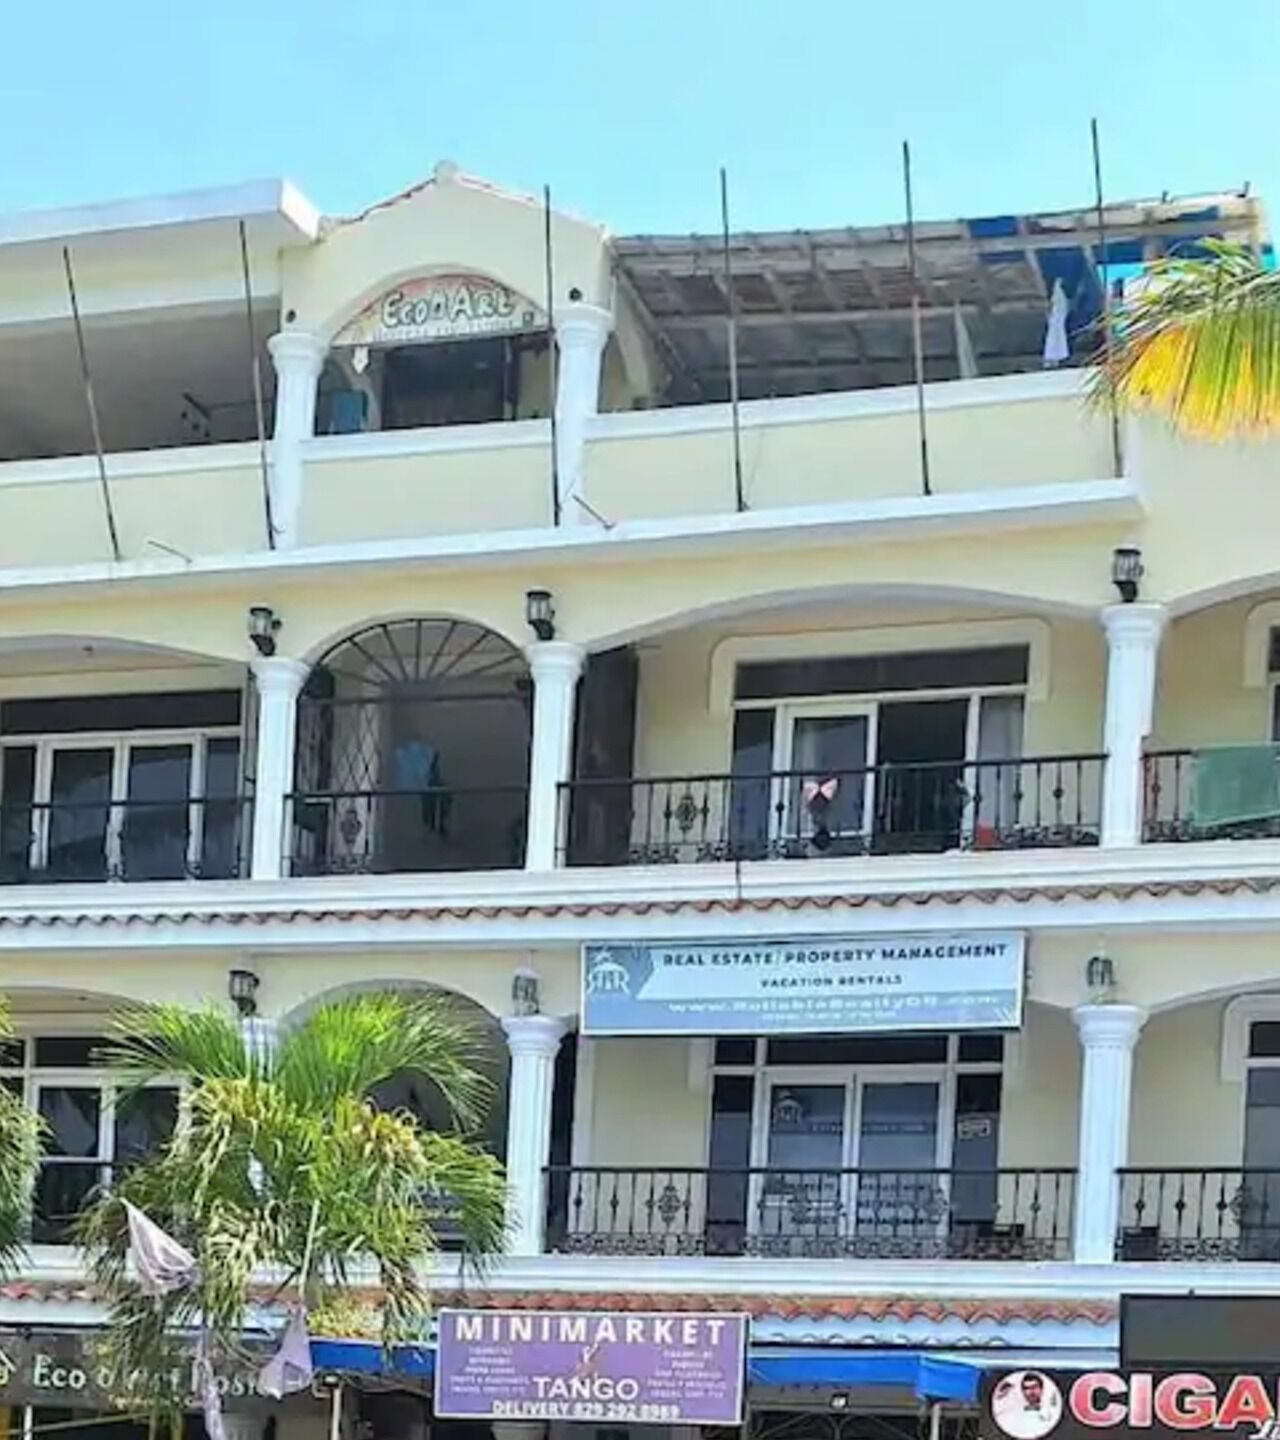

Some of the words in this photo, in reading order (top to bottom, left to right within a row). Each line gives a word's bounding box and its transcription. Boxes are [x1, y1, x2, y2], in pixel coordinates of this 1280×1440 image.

[664, 953, 705, 966] REAL
[712, 951, 773, 966] ESTATE
[785, 948, 875, 964] PROPERTY
[882, 943, 1007, 960] MANAGEMENT
[761, 977, 832, 988] VACATION
[839, 974, 902, 986] RENTALS
[456, 1317, 724, 1345] MINIMARKET
[33, 1354, 86, 1389] Eco
[533, 1376, 638, 1399] TANGO
[492, 1400, 569, 1416] DELIVERY
